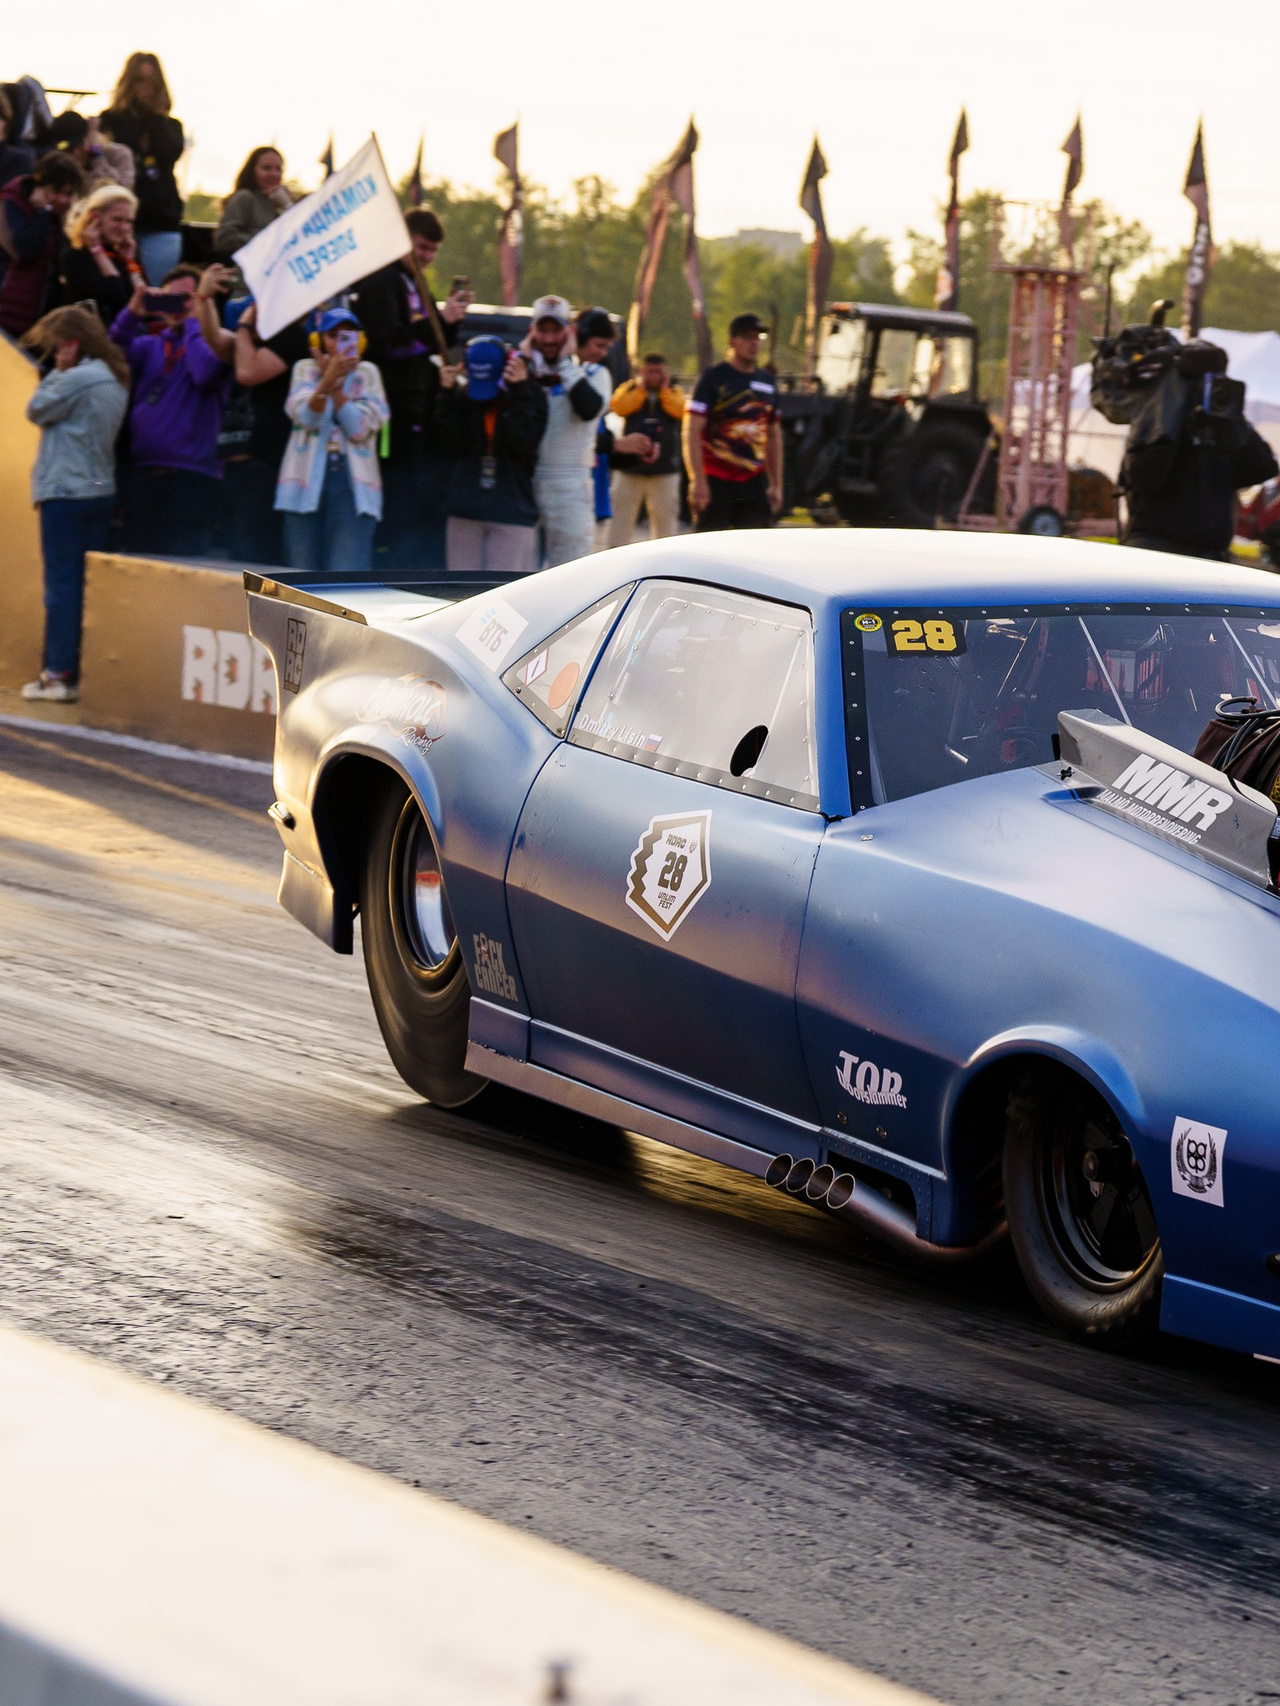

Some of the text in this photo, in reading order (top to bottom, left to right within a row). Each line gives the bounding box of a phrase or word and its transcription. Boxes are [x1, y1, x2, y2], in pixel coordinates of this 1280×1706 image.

[479, 618, 509, 653] ВТБ
[891, 619, 957, 651] 28
[181, 624, 279, 717] RDR
[397, 726, 433, 756] Racing
[579, 713, 647, 749] Dmitry Lisin
[1111, 753, 1234, 832] MMR
[1096, 788, 1202, 845] MALMÖ MOTORRENOVERING
[665, 833, 687, 850] RDRC
[657, 850, 688, 892] 28
[658, 899, 673, 910] FEST
[474, 963, 519, 1002] CANCER
